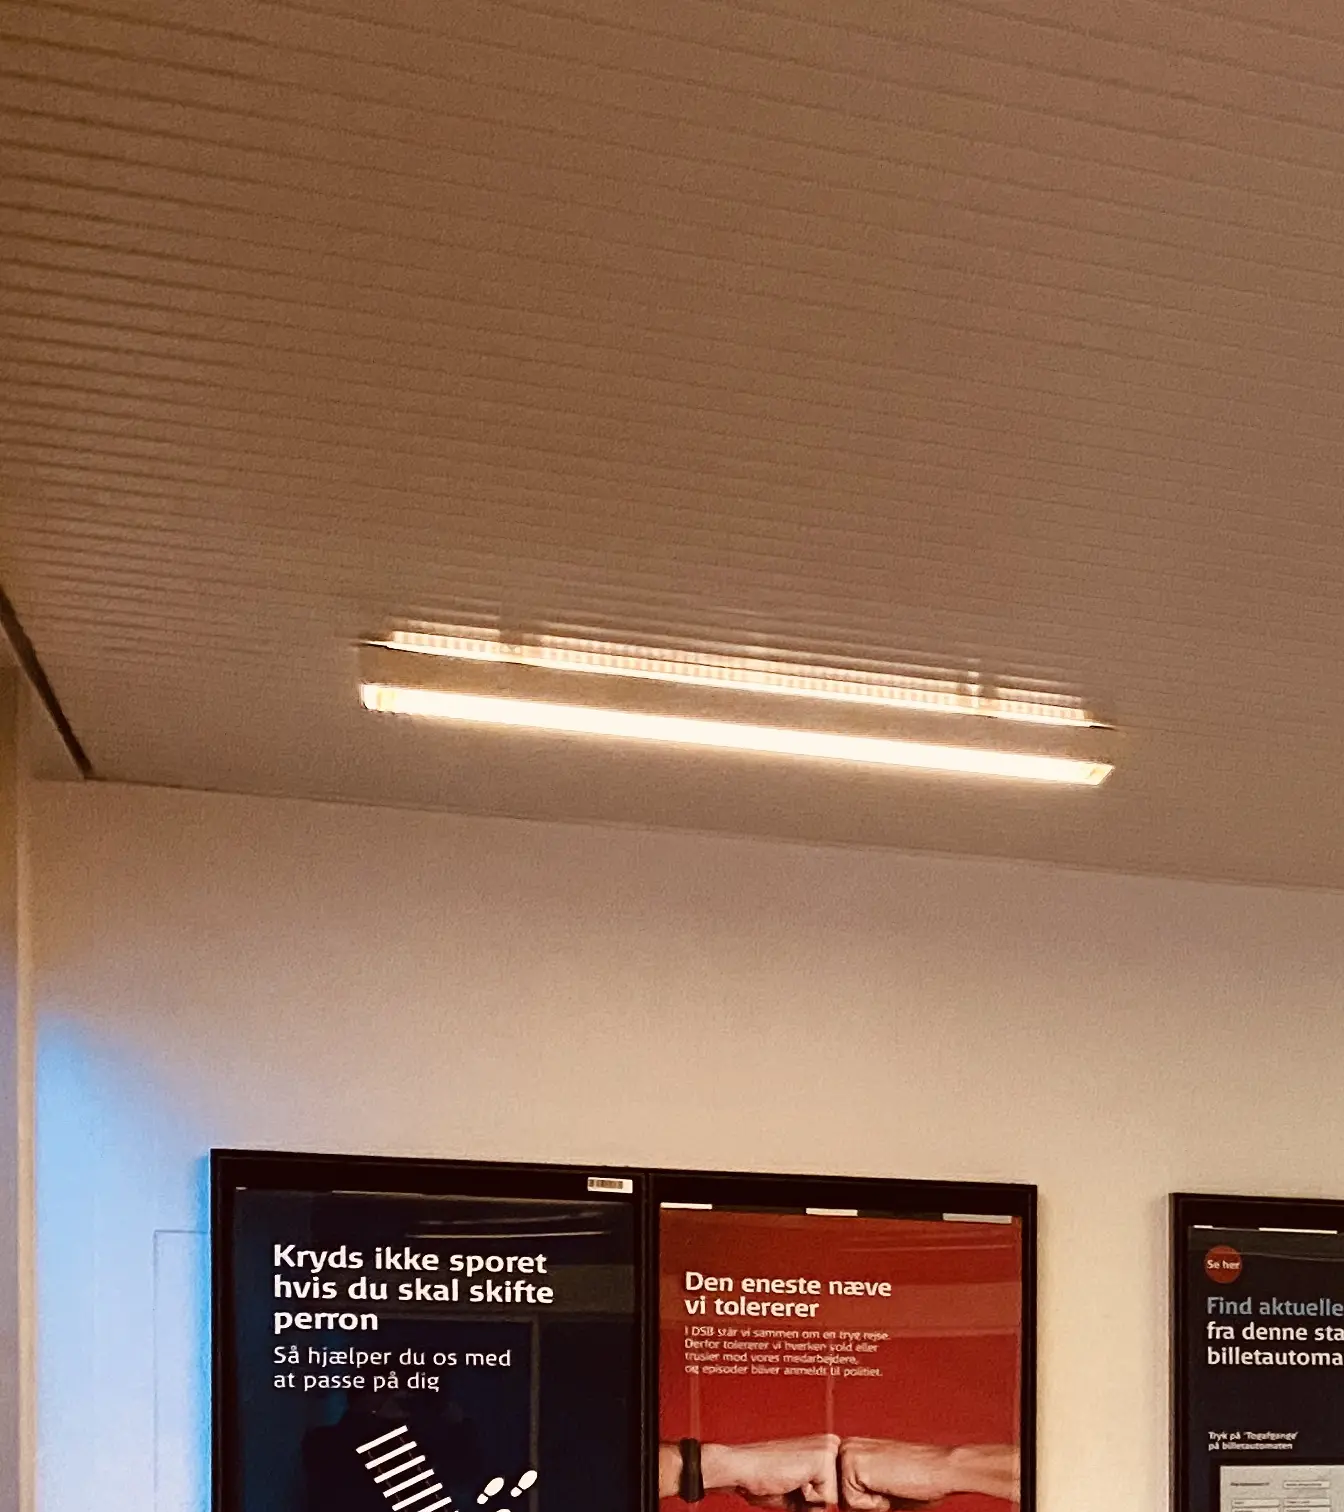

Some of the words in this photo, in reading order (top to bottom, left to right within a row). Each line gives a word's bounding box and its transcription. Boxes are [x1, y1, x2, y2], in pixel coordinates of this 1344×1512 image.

[273, 1243, 364, 1273] Kryds
[375, 1247, 439, 1272] ikke
[449, 1251, 548, 1277] sporet
[1206, 1260, 1220, 1269] Se
[1222, 1260, 1240, 1270] her
[273, 1275, 337, 1300] hvis
[348, 1277, 388, 1301] du
[398, 1279, 459, 1303] skal
[469, 1280, 554, 1305] skifte
[685, 1271, 733, 1292] Den
[741, 1277, 821, 1296] eneste
[829, 1279, 892, 1297] næve
[684, 1296, 706, 1315] vi
[714, 1297, 820, 1318] tolererer
[1207, 1297, 1252, 1315] Find
[1259, 1298, 1344, 1317] aktuelle
[273, 1310, 379, 1335] perron
[1207, 1321, 1235, 1340] fra
[1242, 1322, 1308, 1341] denne
[691, 1326, 714, 1337] DSB
[741, 1327, 751, 1338] vi
[752, 1329, 799, 1339] sammen
[802, 1331, 820, 1340] om
[823, 1331, 836, 1340] en
[685, 1338, 719, 1349] Derfor
[273, 1345, 300, 1365] Så
[308, 1346, 391, 1369] hjælper
[399, 1348, 425, 1366] du
[433, 1352, 458, 1367] os
[465, 1350, 512, 1367] med
[723, 1353, 748, 1363] mod
[702, 1365, 748, 1375] episoder
[273, 1372, 296, 1389] at
[304, 1374, 365, 1392] passe
[373, 1371, 399, 1393] på
[407, 1373, 440, 1393] dig
[1208, 1441, 1220, 1451] på
[1230, 1431, 1241, 1442] på
